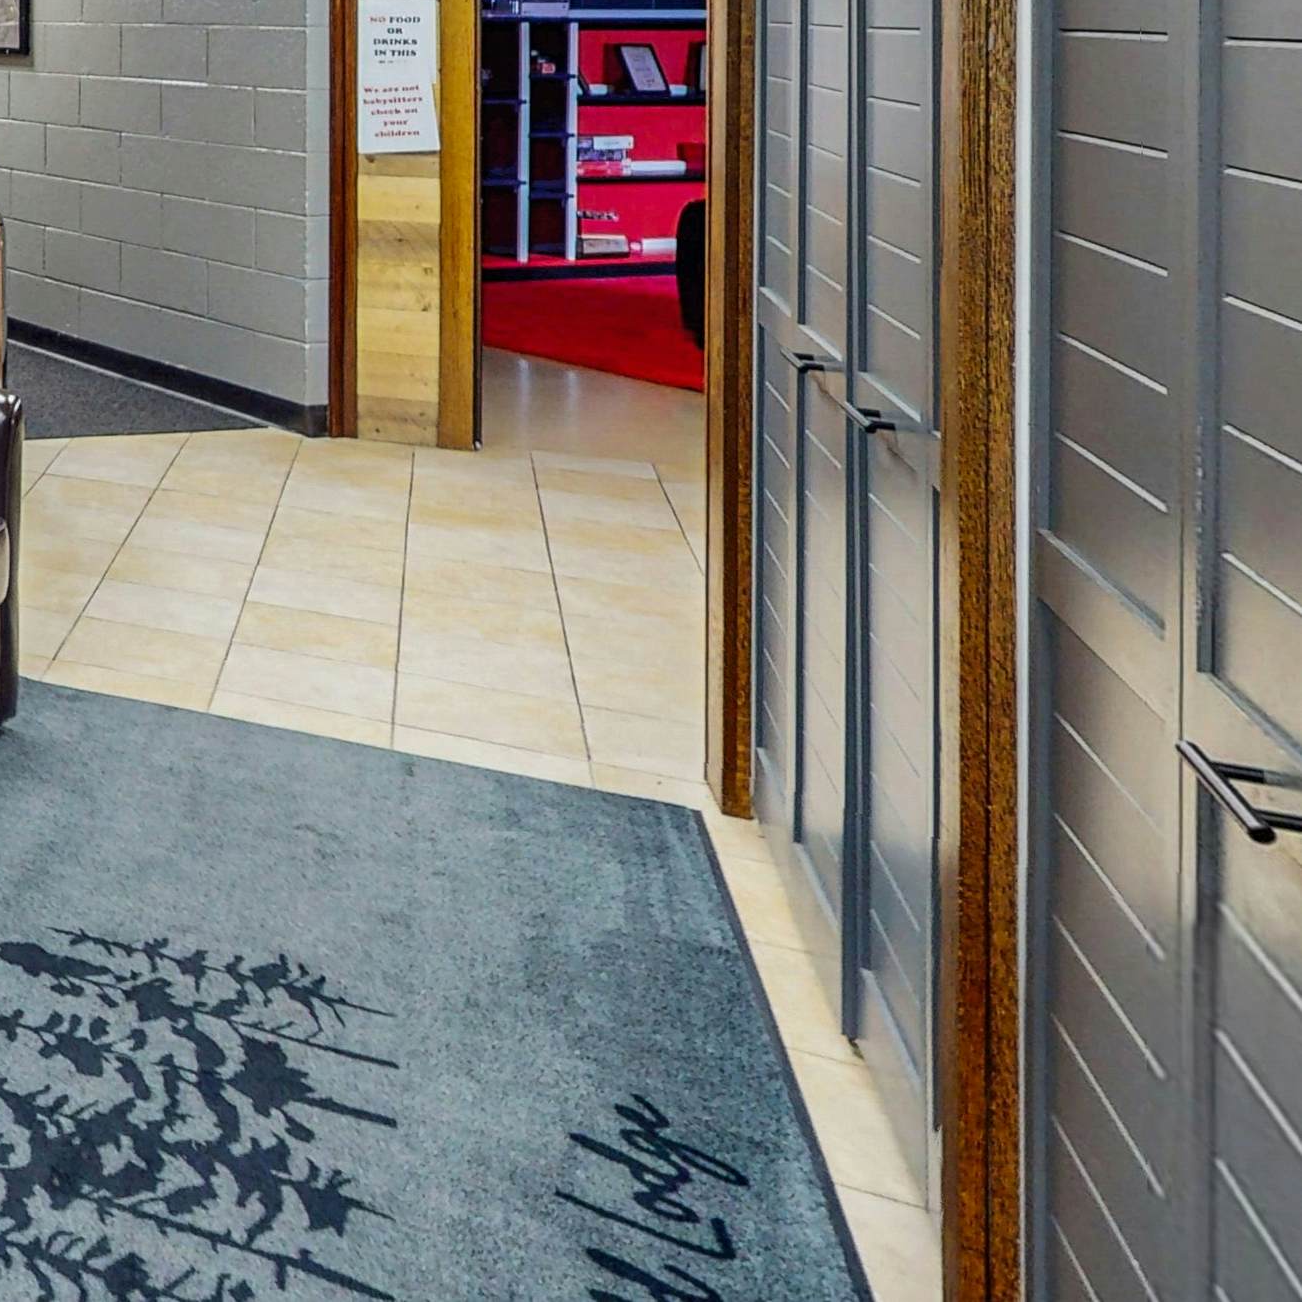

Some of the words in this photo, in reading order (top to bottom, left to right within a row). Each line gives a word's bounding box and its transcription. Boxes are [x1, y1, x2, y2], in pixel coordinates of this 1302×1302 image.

[389, 16, 421, 24] FOOD
[374, 49, 387, 57] IN
[389, 49, 417, 57] THIS
[374, 130, 420, 138] children
